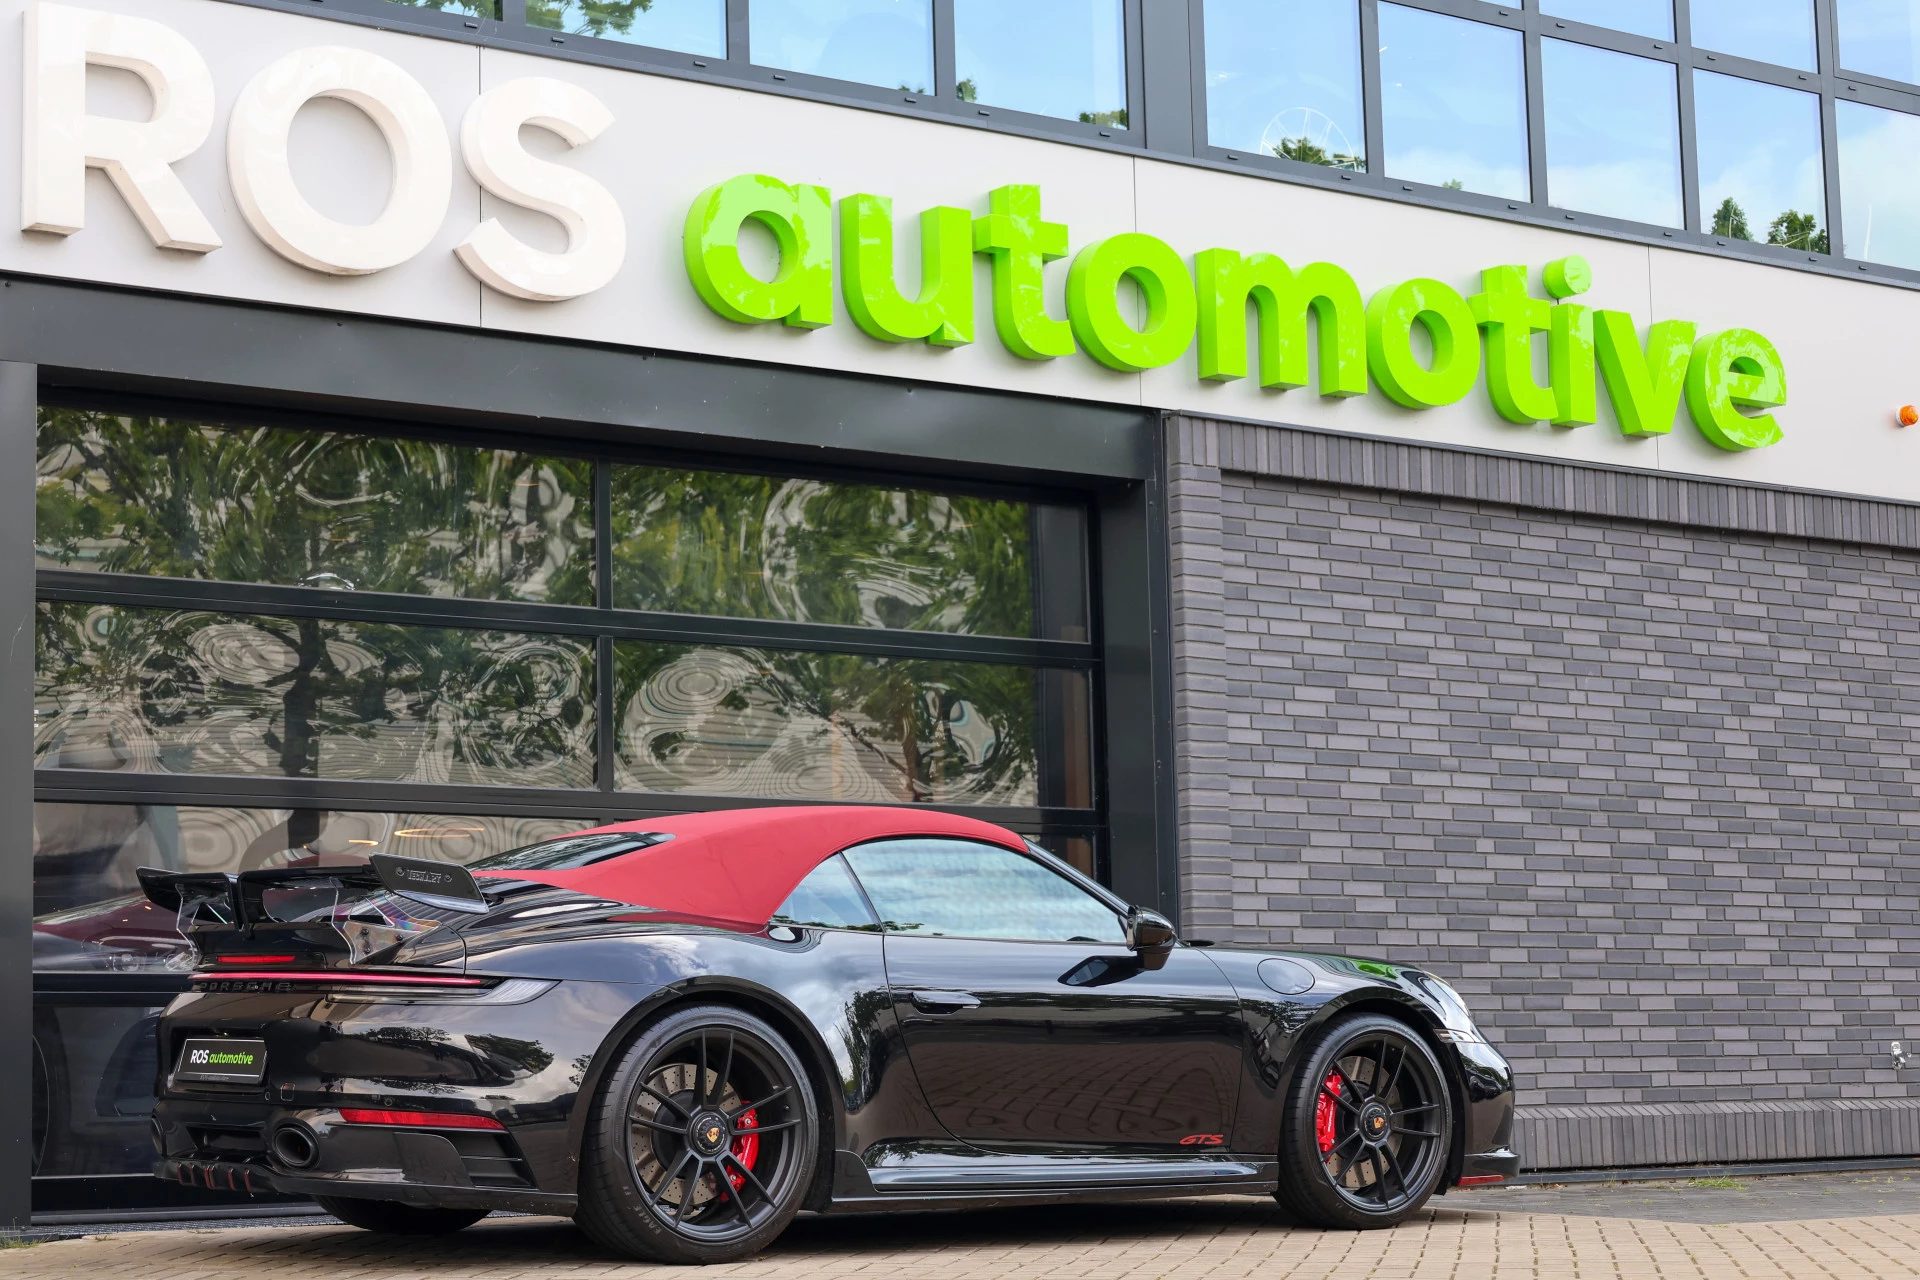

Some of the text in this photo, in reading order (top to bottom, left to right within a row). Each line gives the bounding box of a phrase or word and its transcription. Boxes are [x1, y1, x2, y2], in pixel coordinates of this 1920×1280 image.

[21, 1, 1787, 450] ROS automotive
[190, 1049, 254, 1065] ROS automotive
[1180, 1133, 1224, 1145] GTS
